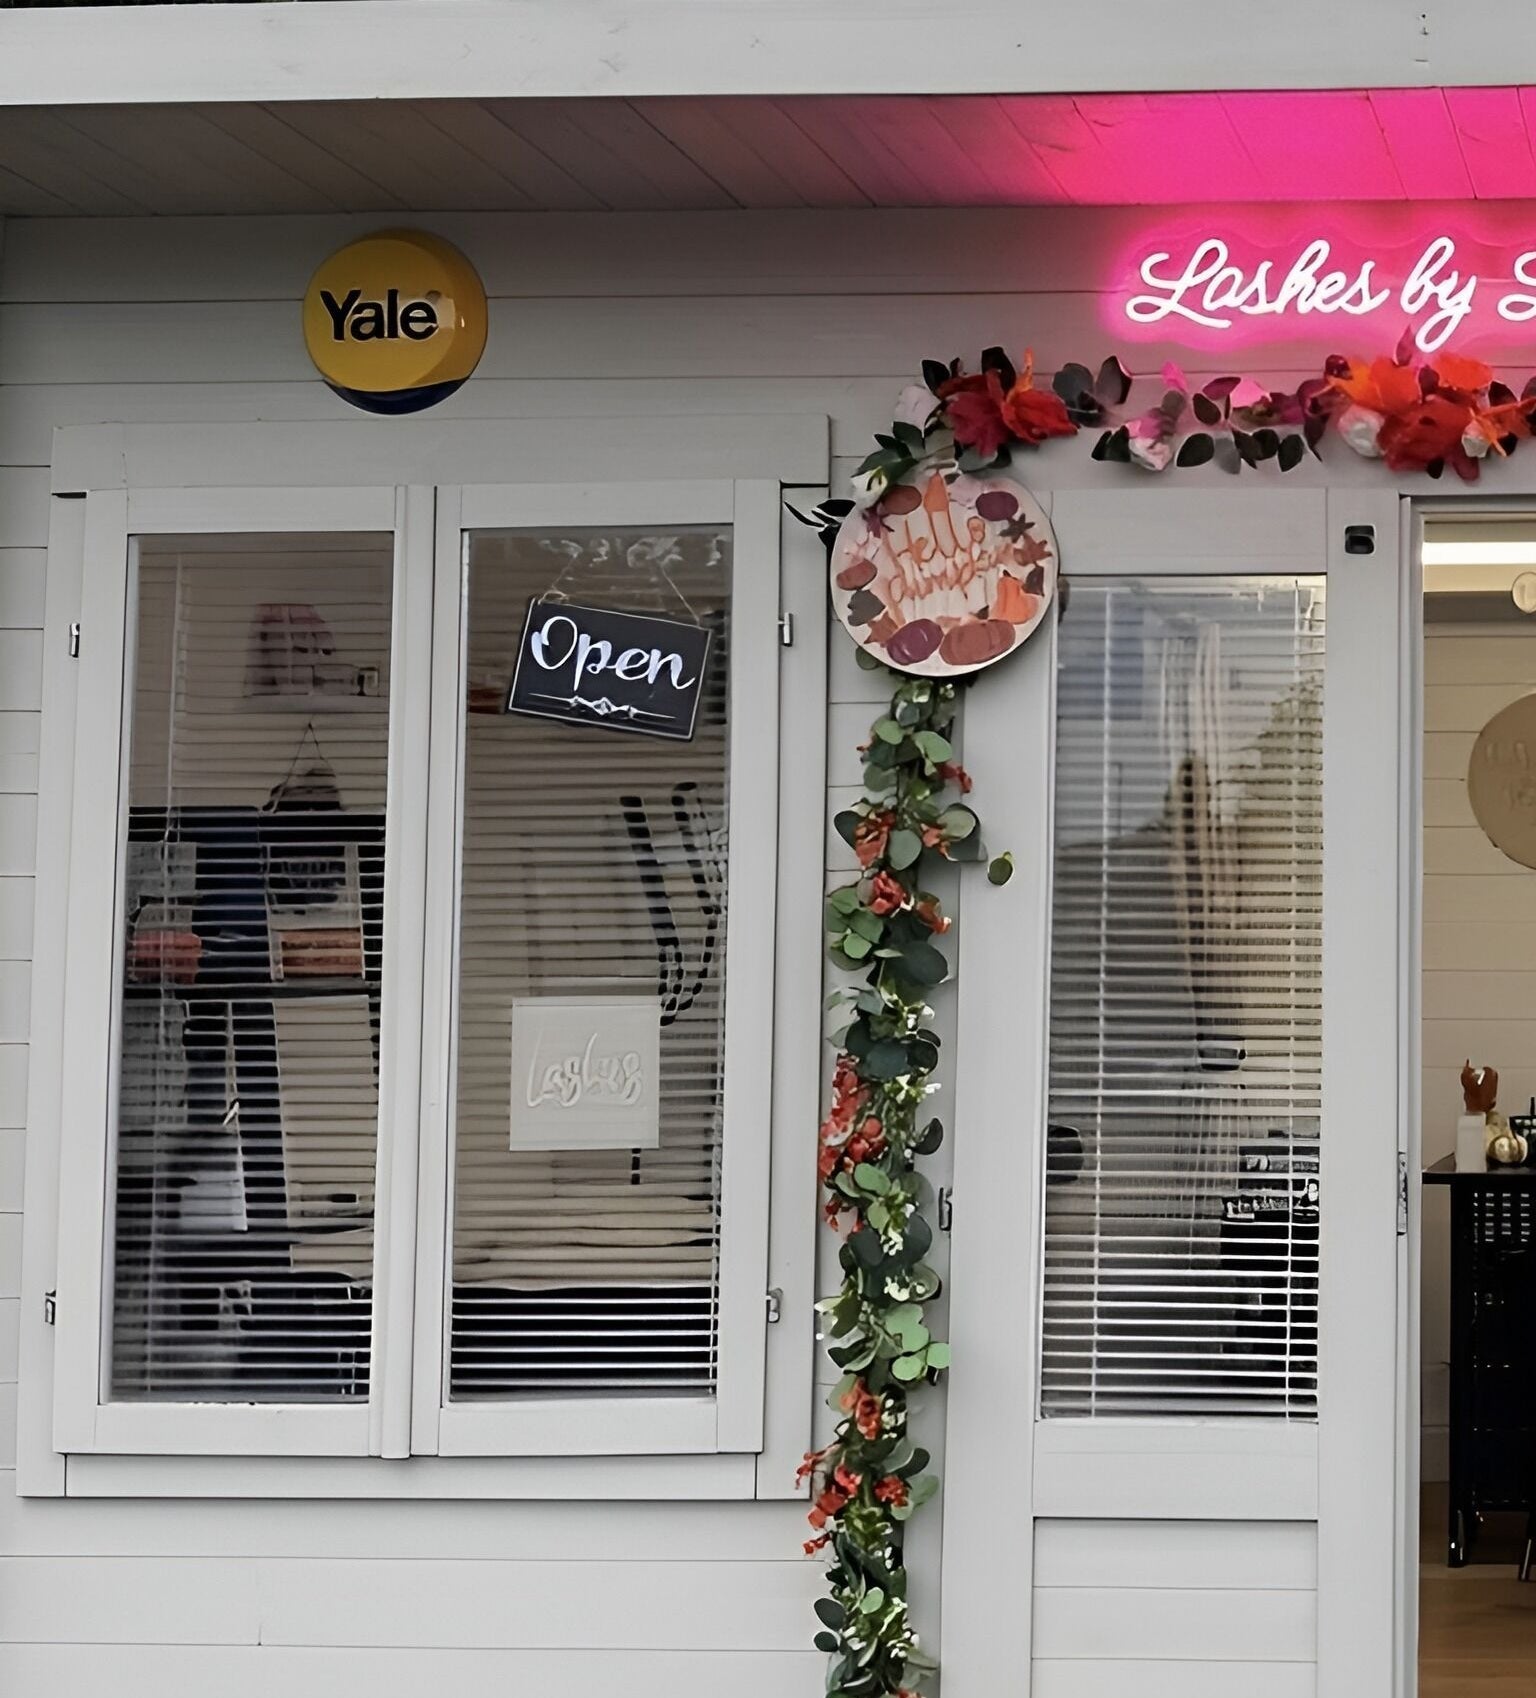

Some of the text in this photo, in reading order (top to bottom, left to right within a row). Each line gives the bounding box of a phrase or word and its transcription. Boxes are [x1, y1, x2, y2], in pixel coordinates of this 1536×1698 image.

[319, 288, 439, 341] Yale
[1125, 237, 1389, 329] Lashes
[1400, 235, 1478, 353] by
[531, 615, 696, 692] Open
